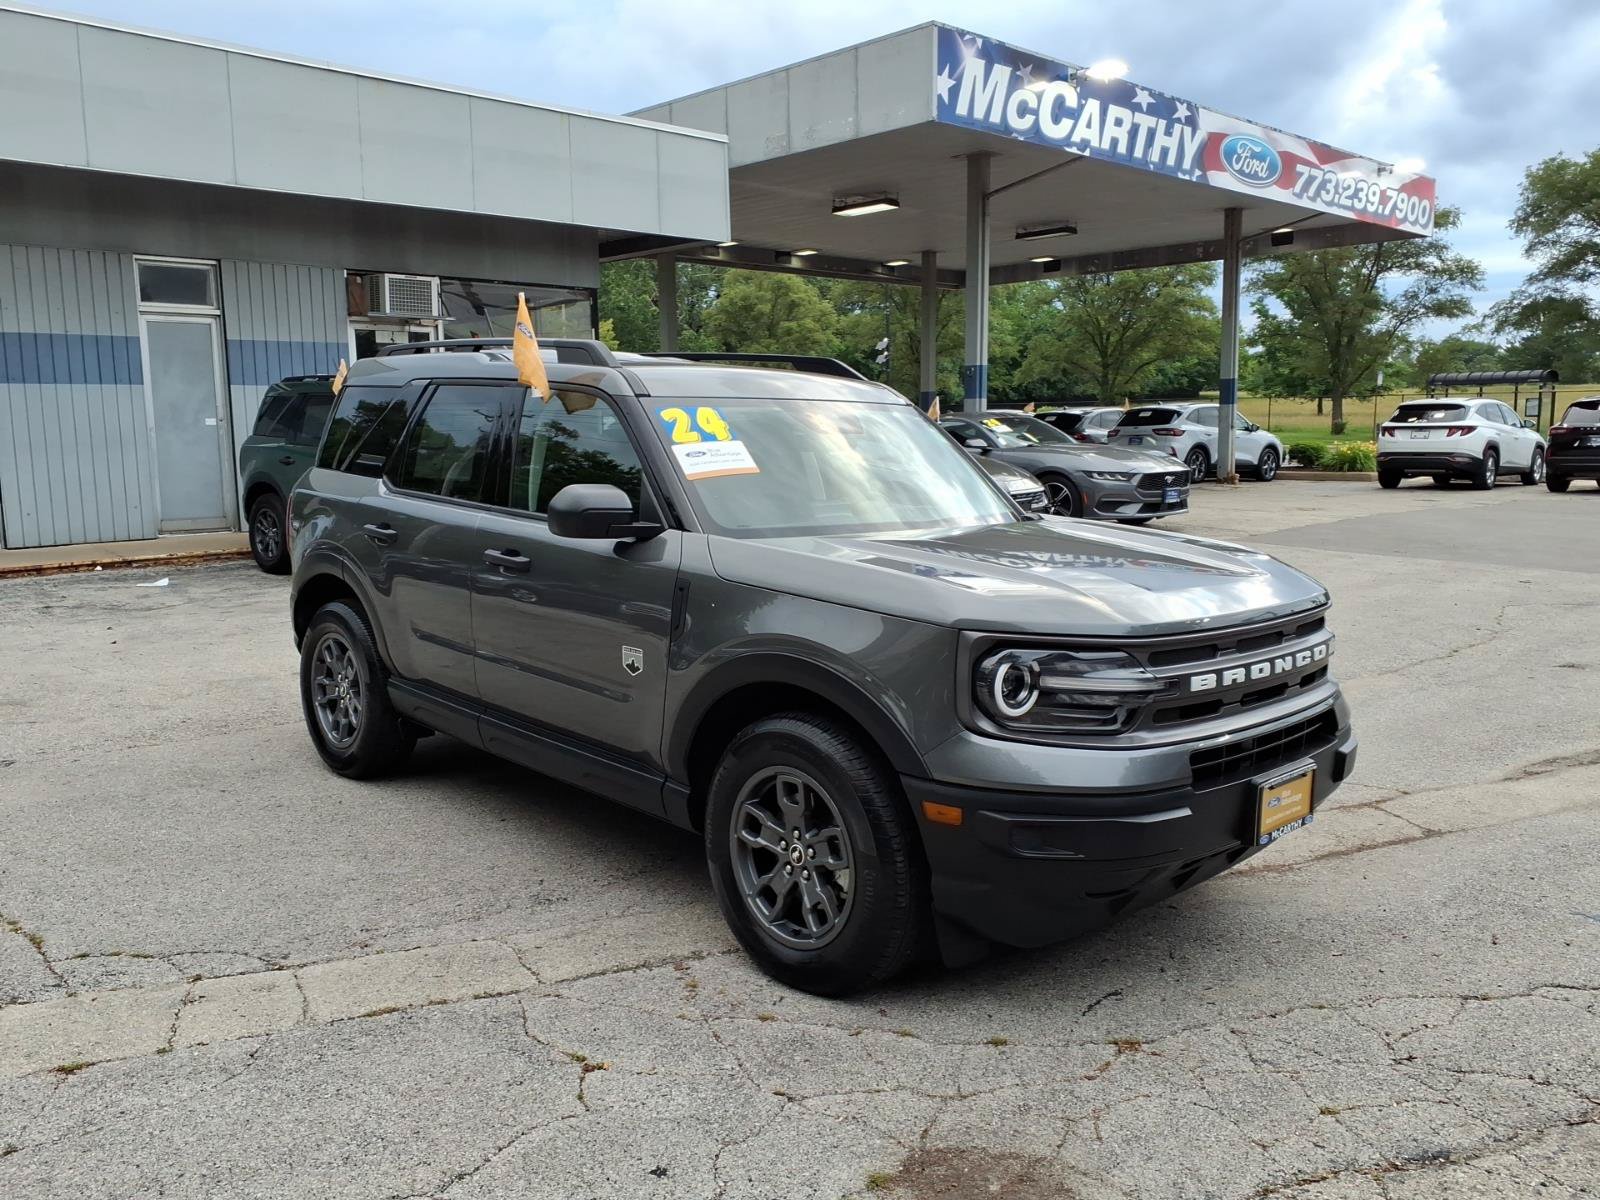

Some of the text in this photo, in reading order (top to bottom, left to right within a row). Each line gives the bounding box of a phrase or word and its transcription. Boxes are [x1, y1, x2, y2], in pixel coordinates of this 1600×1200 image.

[955, 56, 1202, 170] McCARTHY
[1232, 141, 1270, 178] Ford
[1294, 164, 1430, 226] 773.239.7900
[660, 406, 732, 443] 24
[1190, 644, 1327, 692] BRONCO
